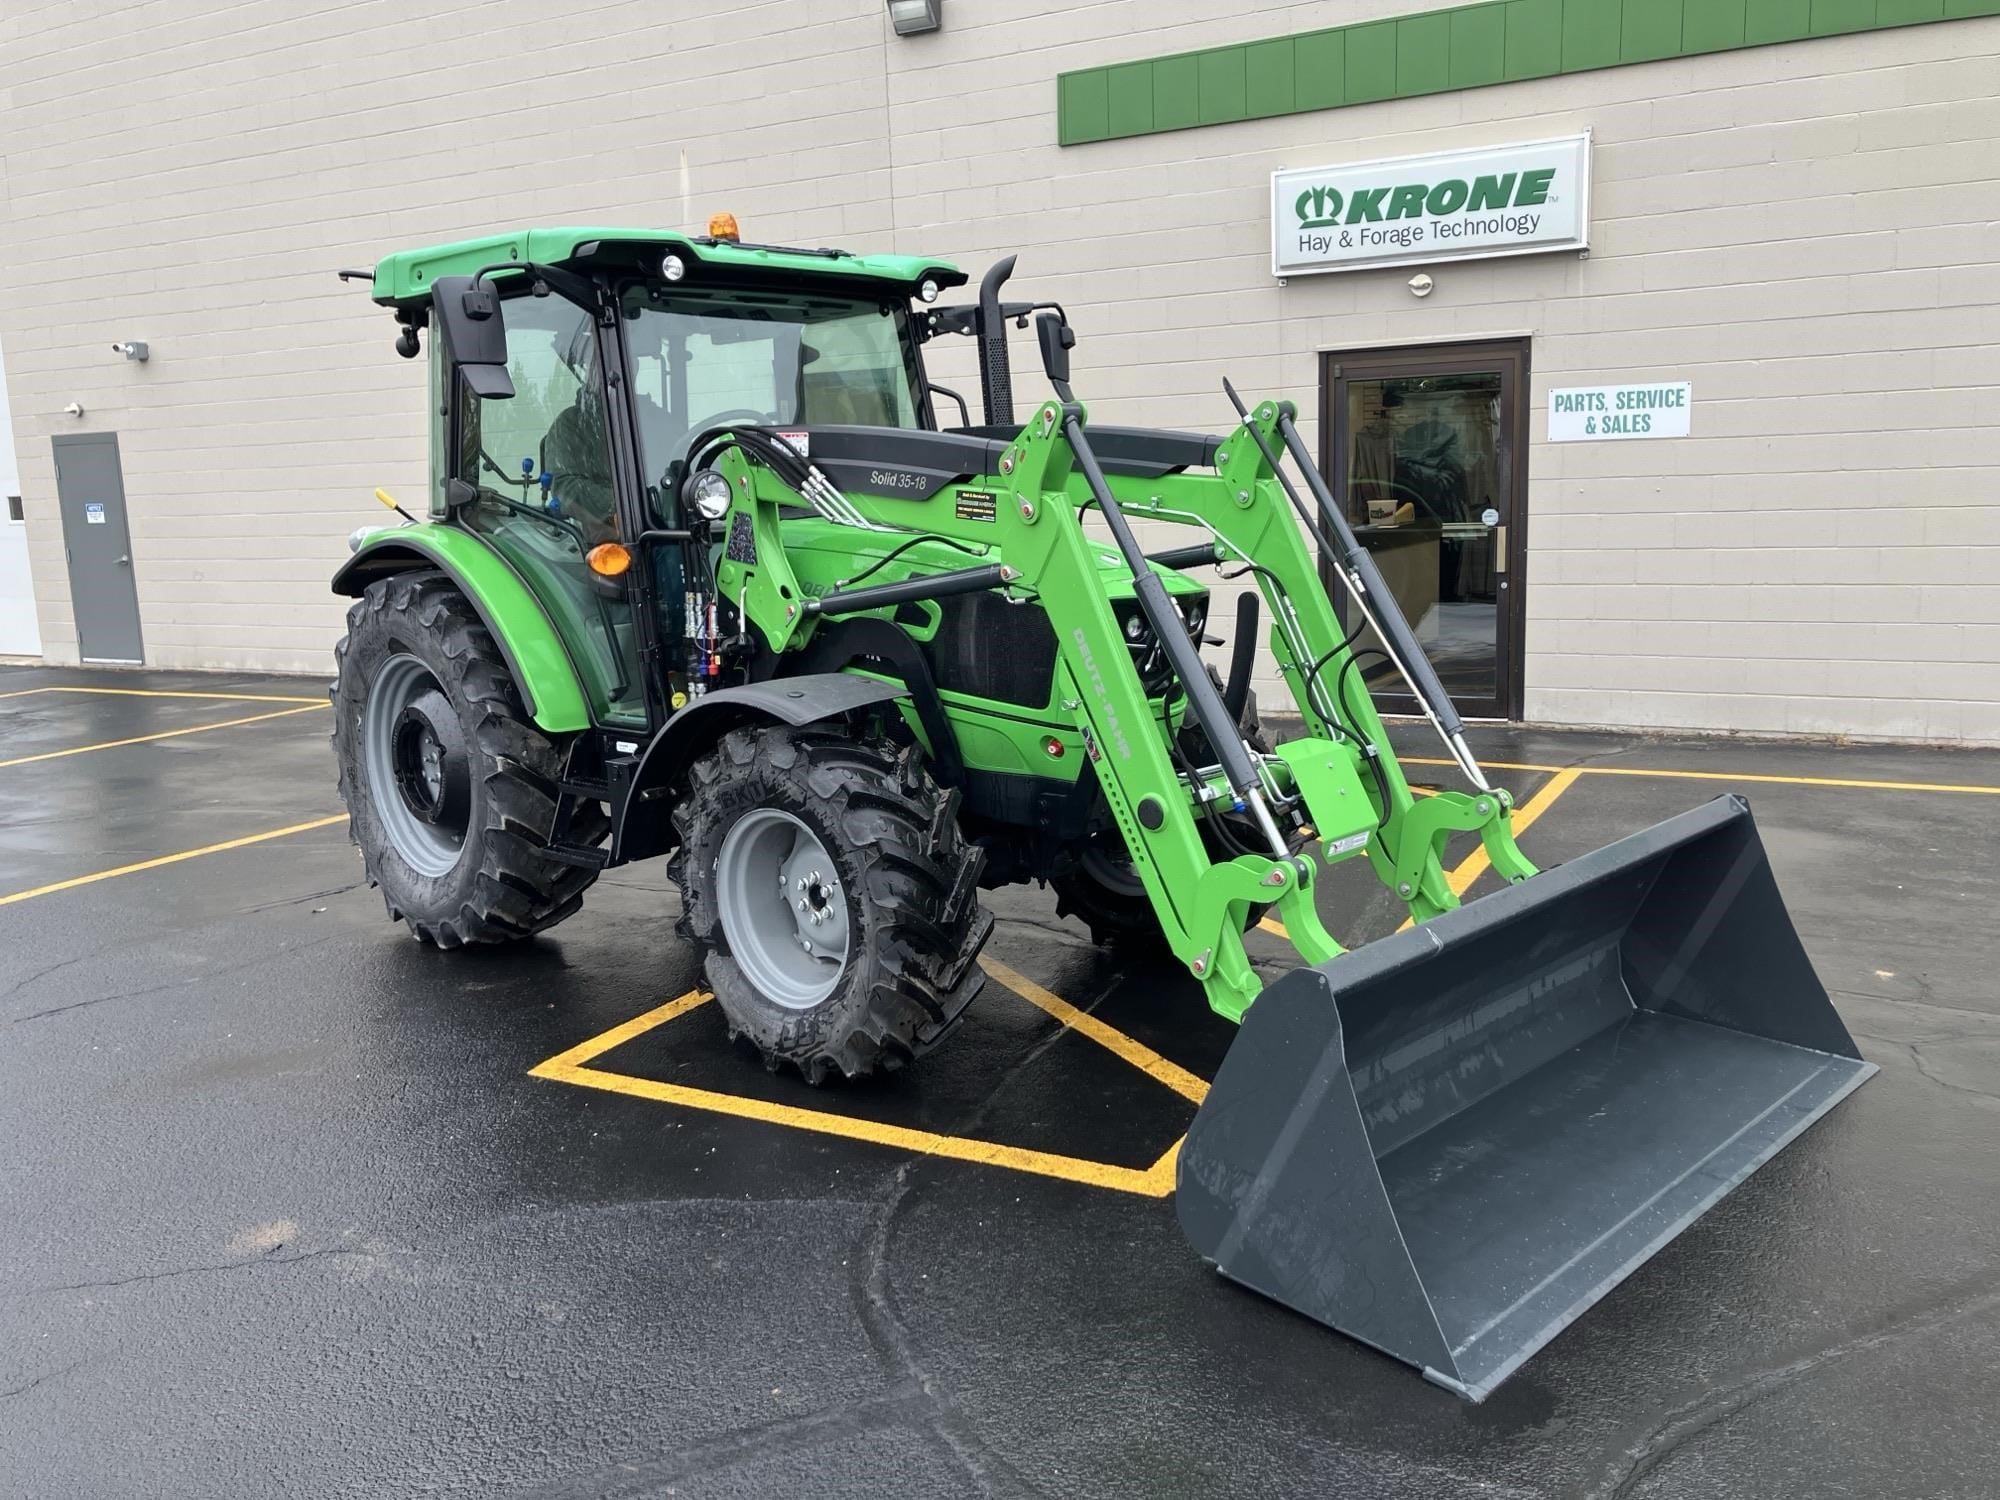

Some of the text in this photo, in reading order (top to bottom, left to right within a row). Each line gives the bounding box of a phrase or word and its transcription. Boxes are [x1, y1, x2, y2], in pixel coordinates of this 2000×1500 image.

[1344, 168, 1556, 225] KRONE
[1299, 213, 1541, 254] Hay & Forage Technology
[1554, 388, 1685, 413] PARTS, SERVICE
[1585, 413, 1651, 435] & SALES
[870, 470, 927, 490] Solid 35-18
